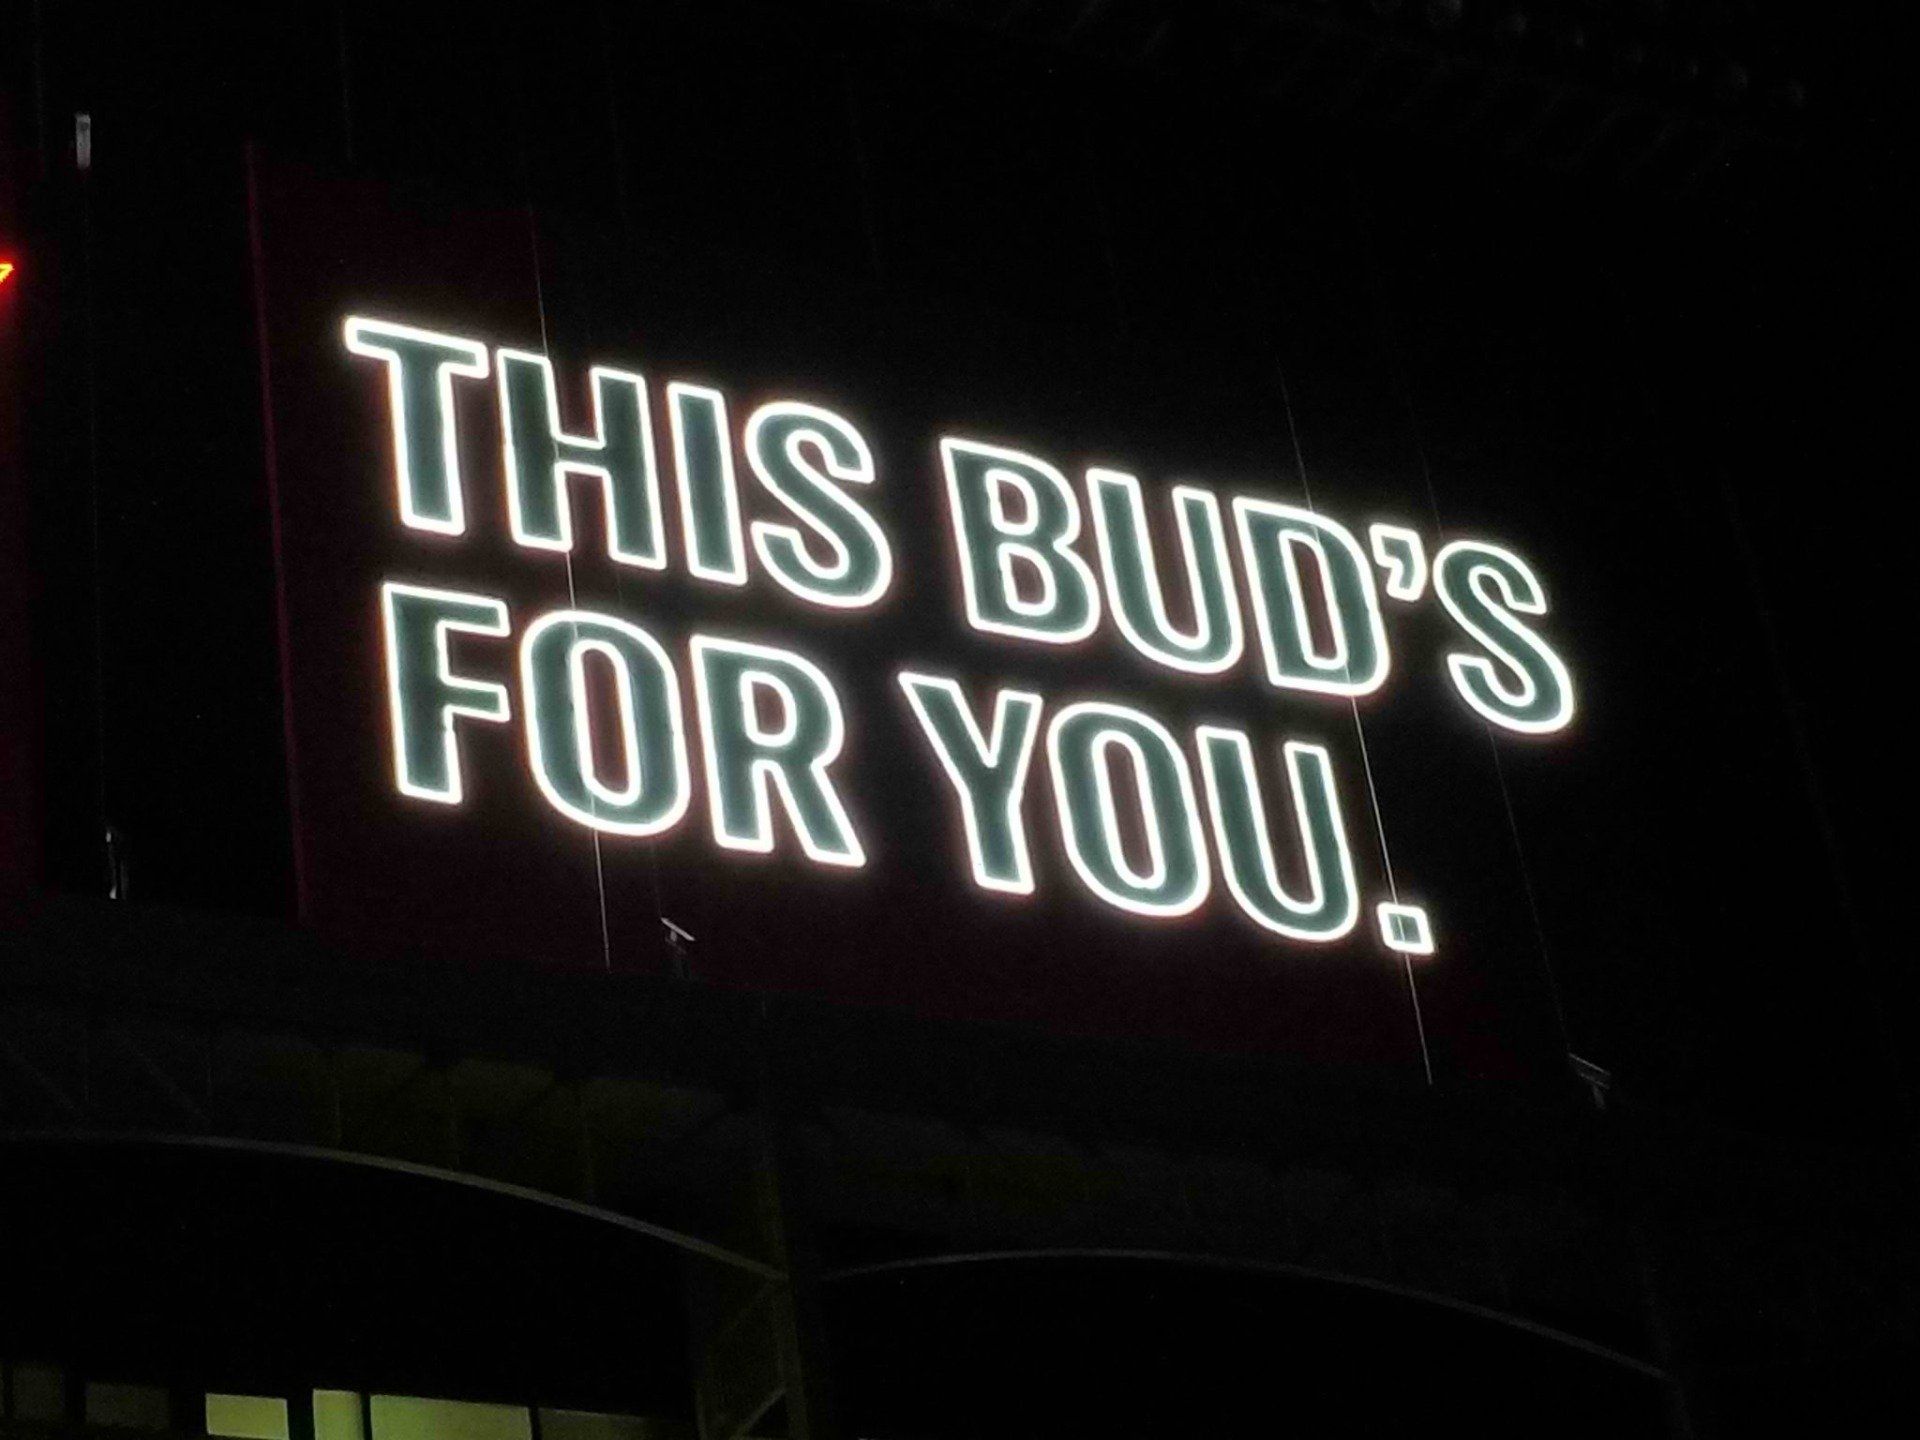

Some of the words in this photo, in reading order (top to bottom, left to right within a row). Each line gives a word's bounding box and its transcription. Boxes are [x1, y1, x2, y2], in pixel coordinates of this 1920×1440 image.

[342, 315, 893, 608] THIS
[940, 436, 1576, 733] BUD'S
[381, 581, 866, 867] FOR
[898, 670, 1434, 956] YOU.
